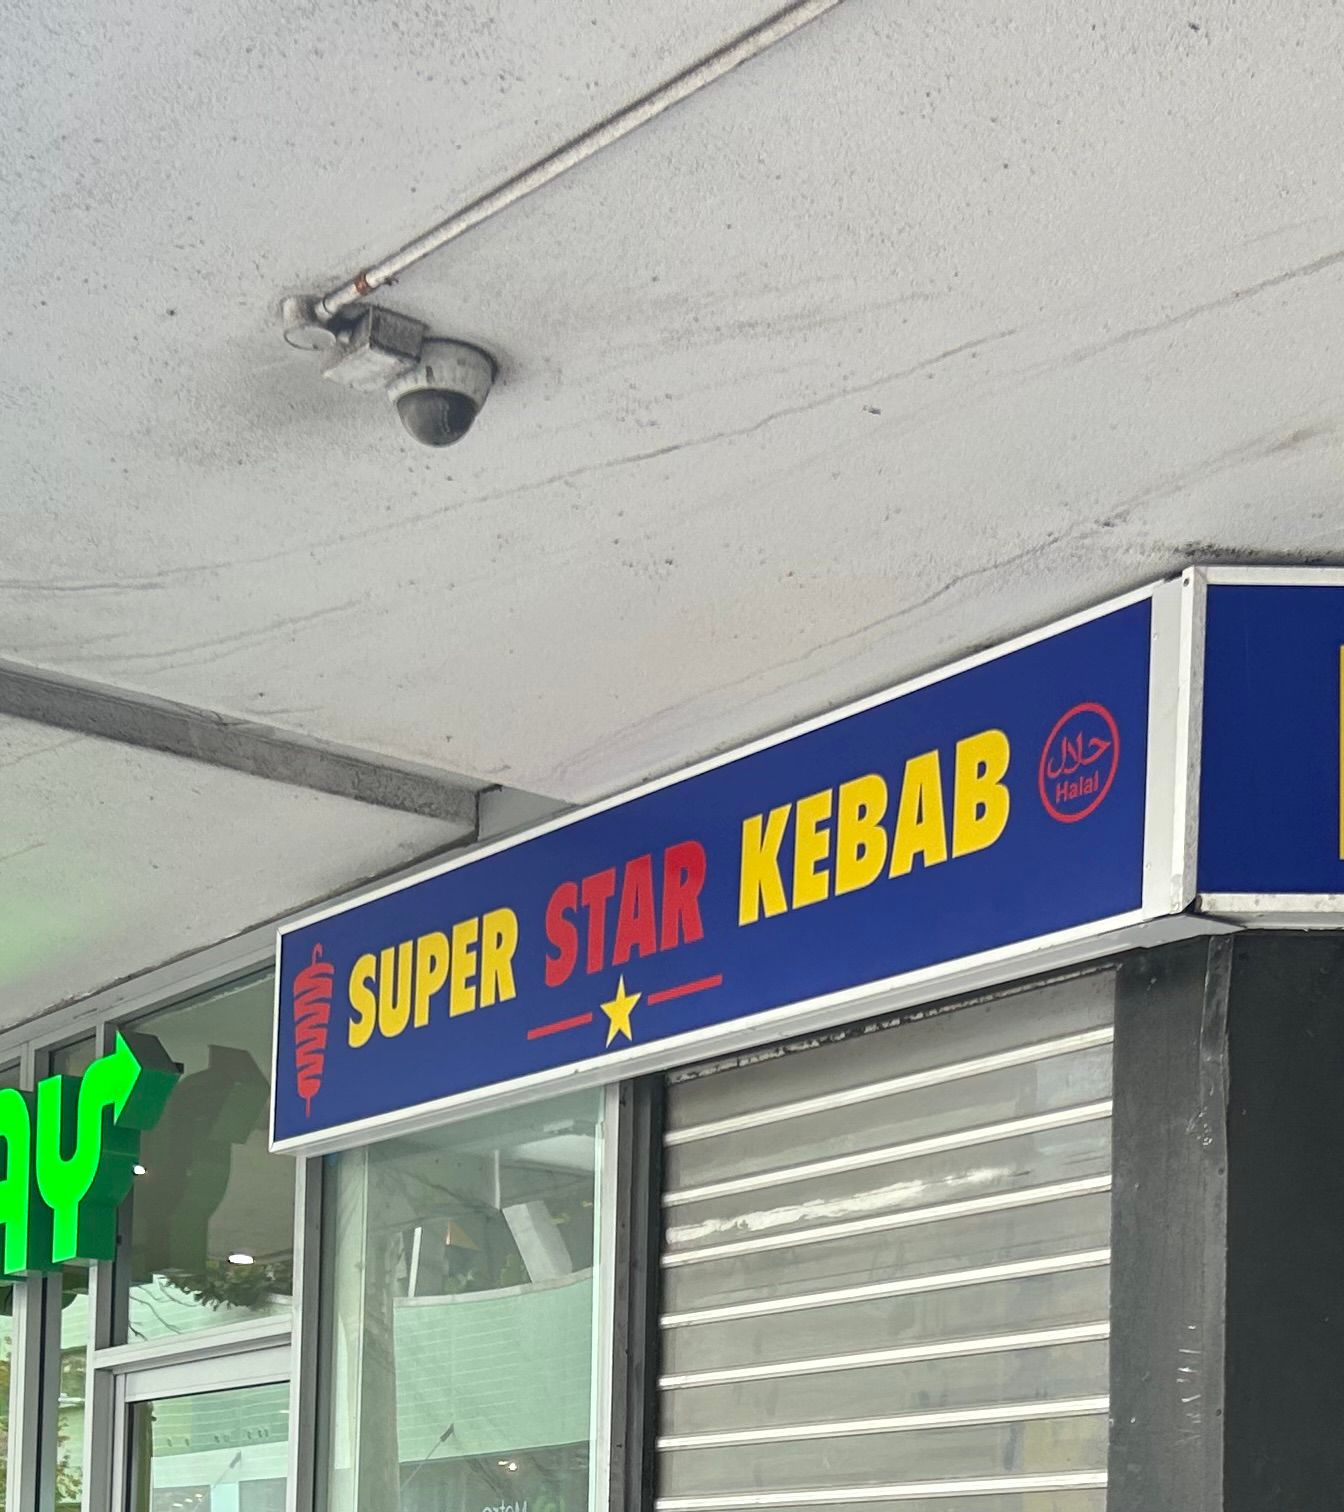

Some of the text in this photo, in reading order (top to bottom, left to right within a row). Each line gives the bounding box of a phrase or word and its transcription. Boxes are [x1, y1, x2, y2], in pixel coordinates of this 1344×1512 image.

[1047, 730, 1112, 779] حلال
[1056, 770, 1099, 804] Halal
[347, 728, 1011, 1048] SUPER STAR KEBAB
